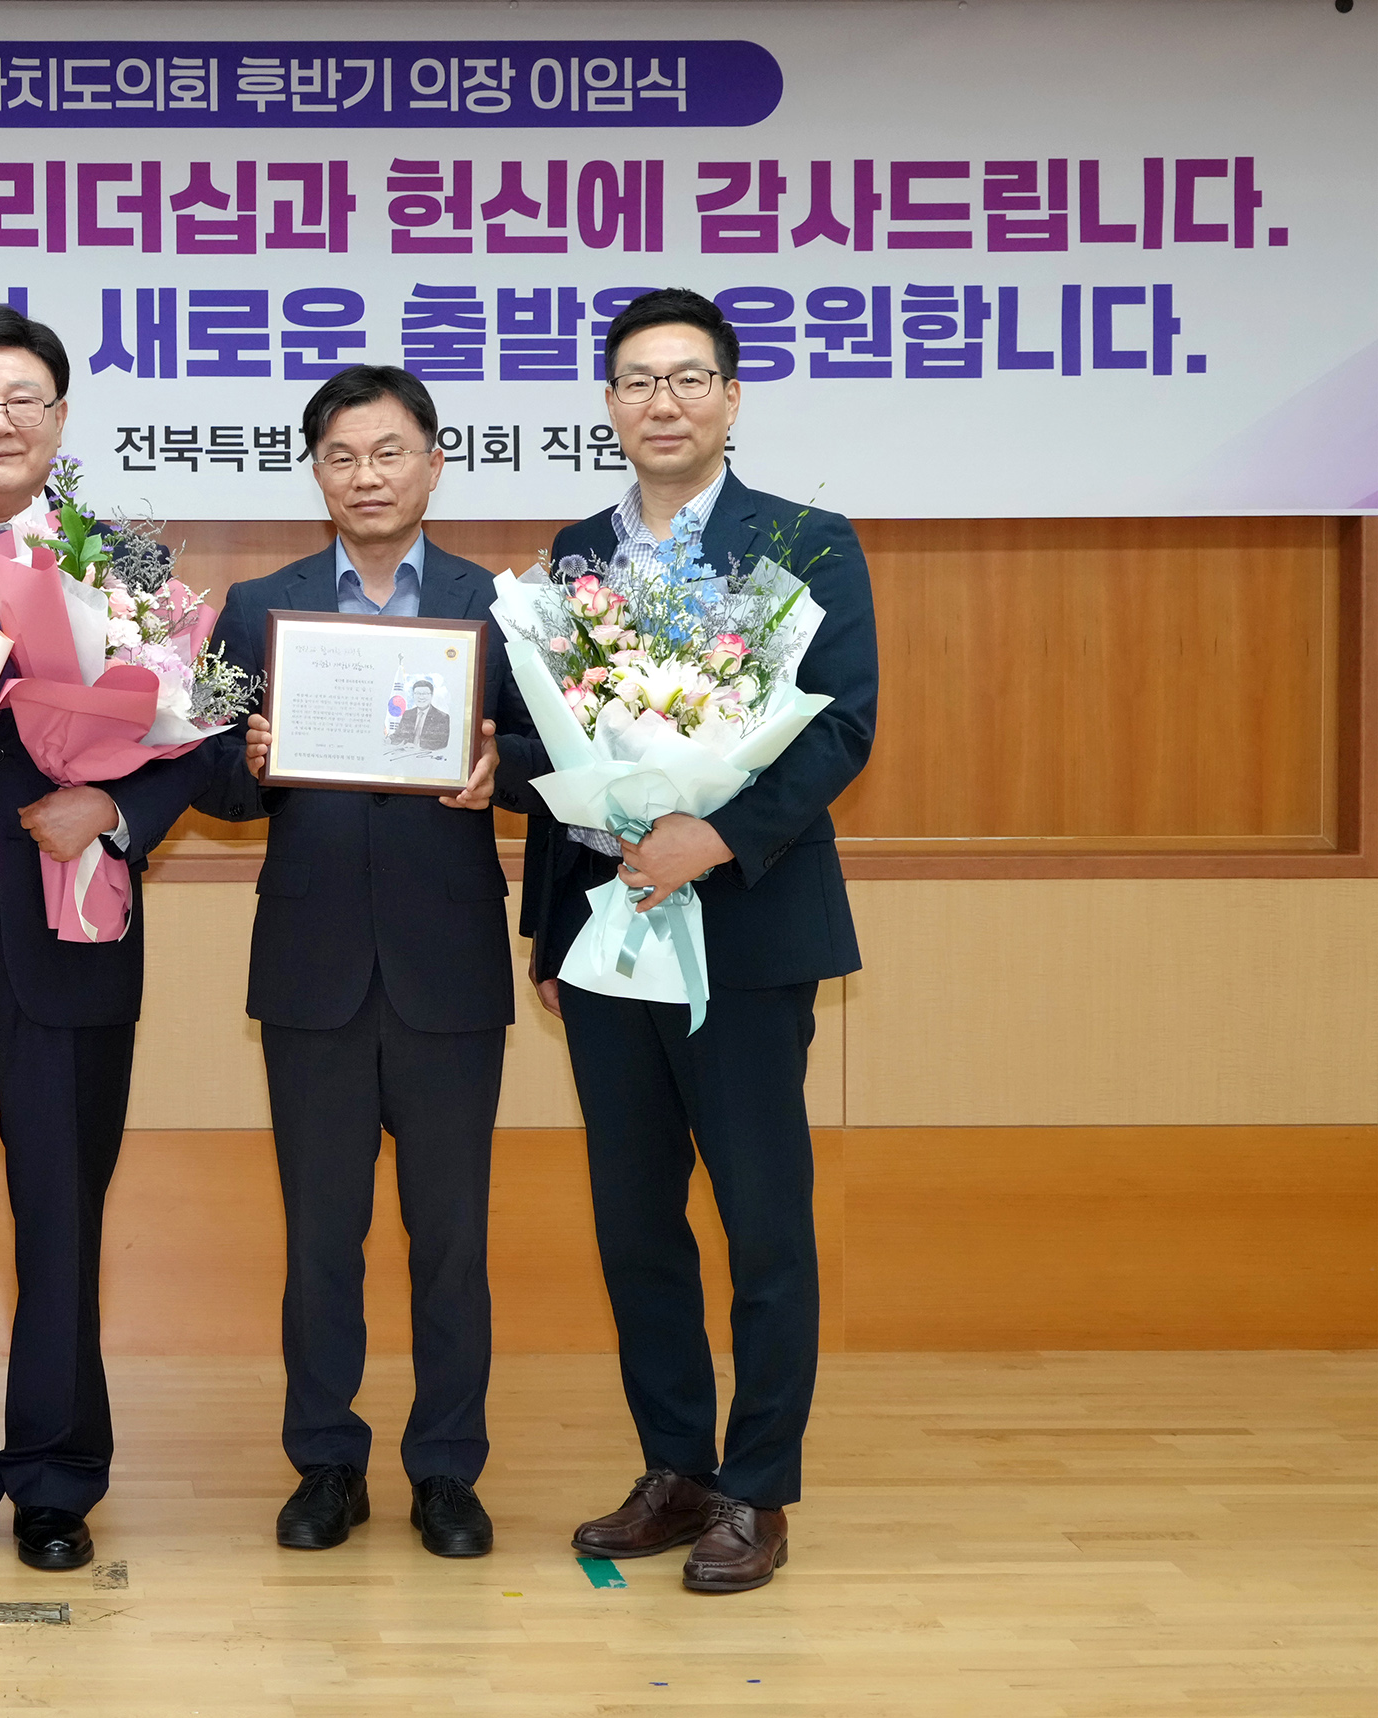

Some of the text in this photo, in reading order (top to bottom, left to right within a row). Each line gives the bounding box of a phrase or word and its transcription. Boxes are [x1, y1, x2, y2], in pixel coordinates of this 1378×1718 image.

[237, 58, 394, 114] 후반기
[410, 58, 517, 114] 의장
[531, 58, 688, 114] 이임식
[388, 159, 665, 255] 헌신에
[696, 157, 1289, 255] 감사드립니다.
[89, 286, 368, 382] 새로운
[713, 284, 1208, 383] 응원합니다.
[539, 424, 628, 473] 직원
